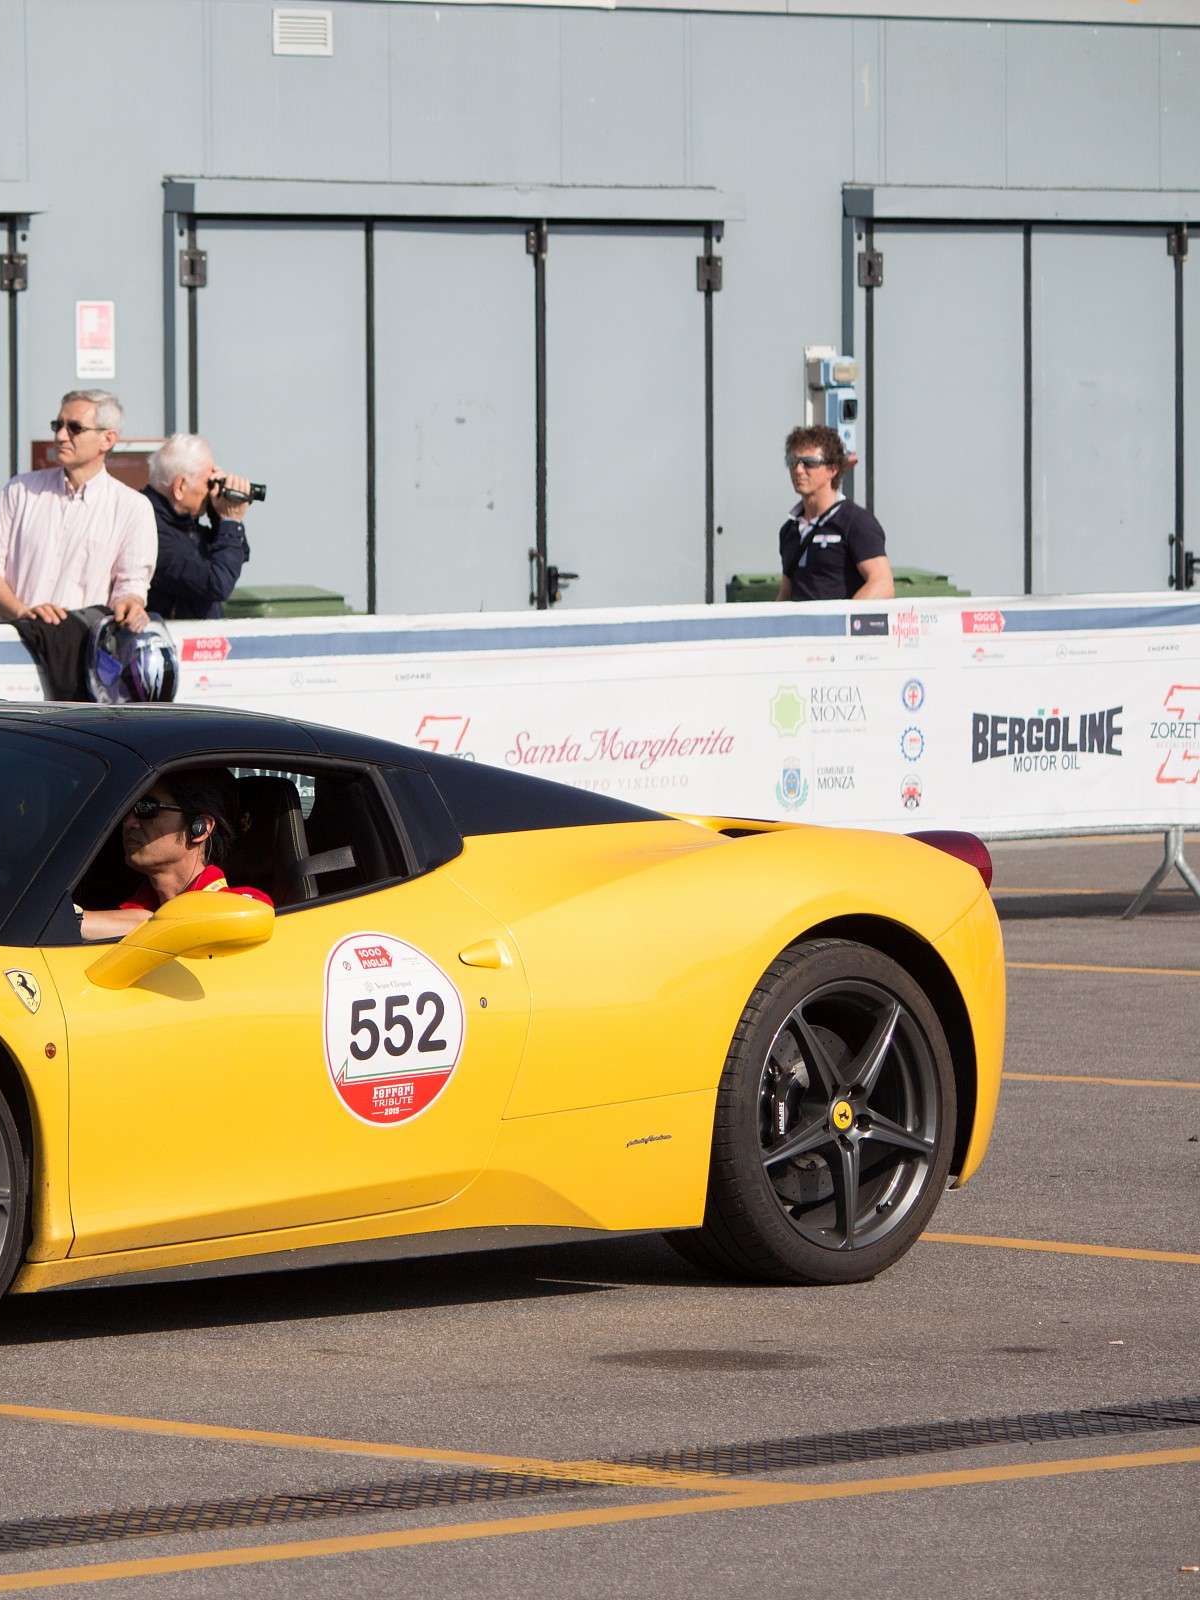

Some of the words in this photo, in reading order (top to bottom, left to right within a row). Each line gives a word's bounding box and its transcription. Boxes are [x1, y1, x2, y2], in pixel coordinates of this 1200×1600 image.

[920, 614, 938, 624] 2015
[973, 612, 996, 622] 1000
[973, 623, 999, 633] MIGLIA
[197, 638, 221, 649] 1000
[193, 650, 222, 661] MIGLIA
[810, 686, 862, 703] REGGIA
[810, 704, 867, 722] MONZA
[971, 705, 1124, 764] BERGOLINE
[505, 731, 583, 766] Santa
[583, 724, 736, 771] Margherita
[1013, 755, 1058, 773] MOTOR
[1061, 754, 1081, 770] OIL
[816, 766, 845, 775] COMUNE
[817, 776, 855, 789] MONZA
[357, 947, 382, 958] 1000
[361, 957, 390, 969] MIGLIA
[350, 991, 447, 1061] 552
[372, 1082, 415, 1100] Ferrari
[372, 1095, 414, 1108] TRIBUTE
[384, 1106, 400, 1116] 2015
